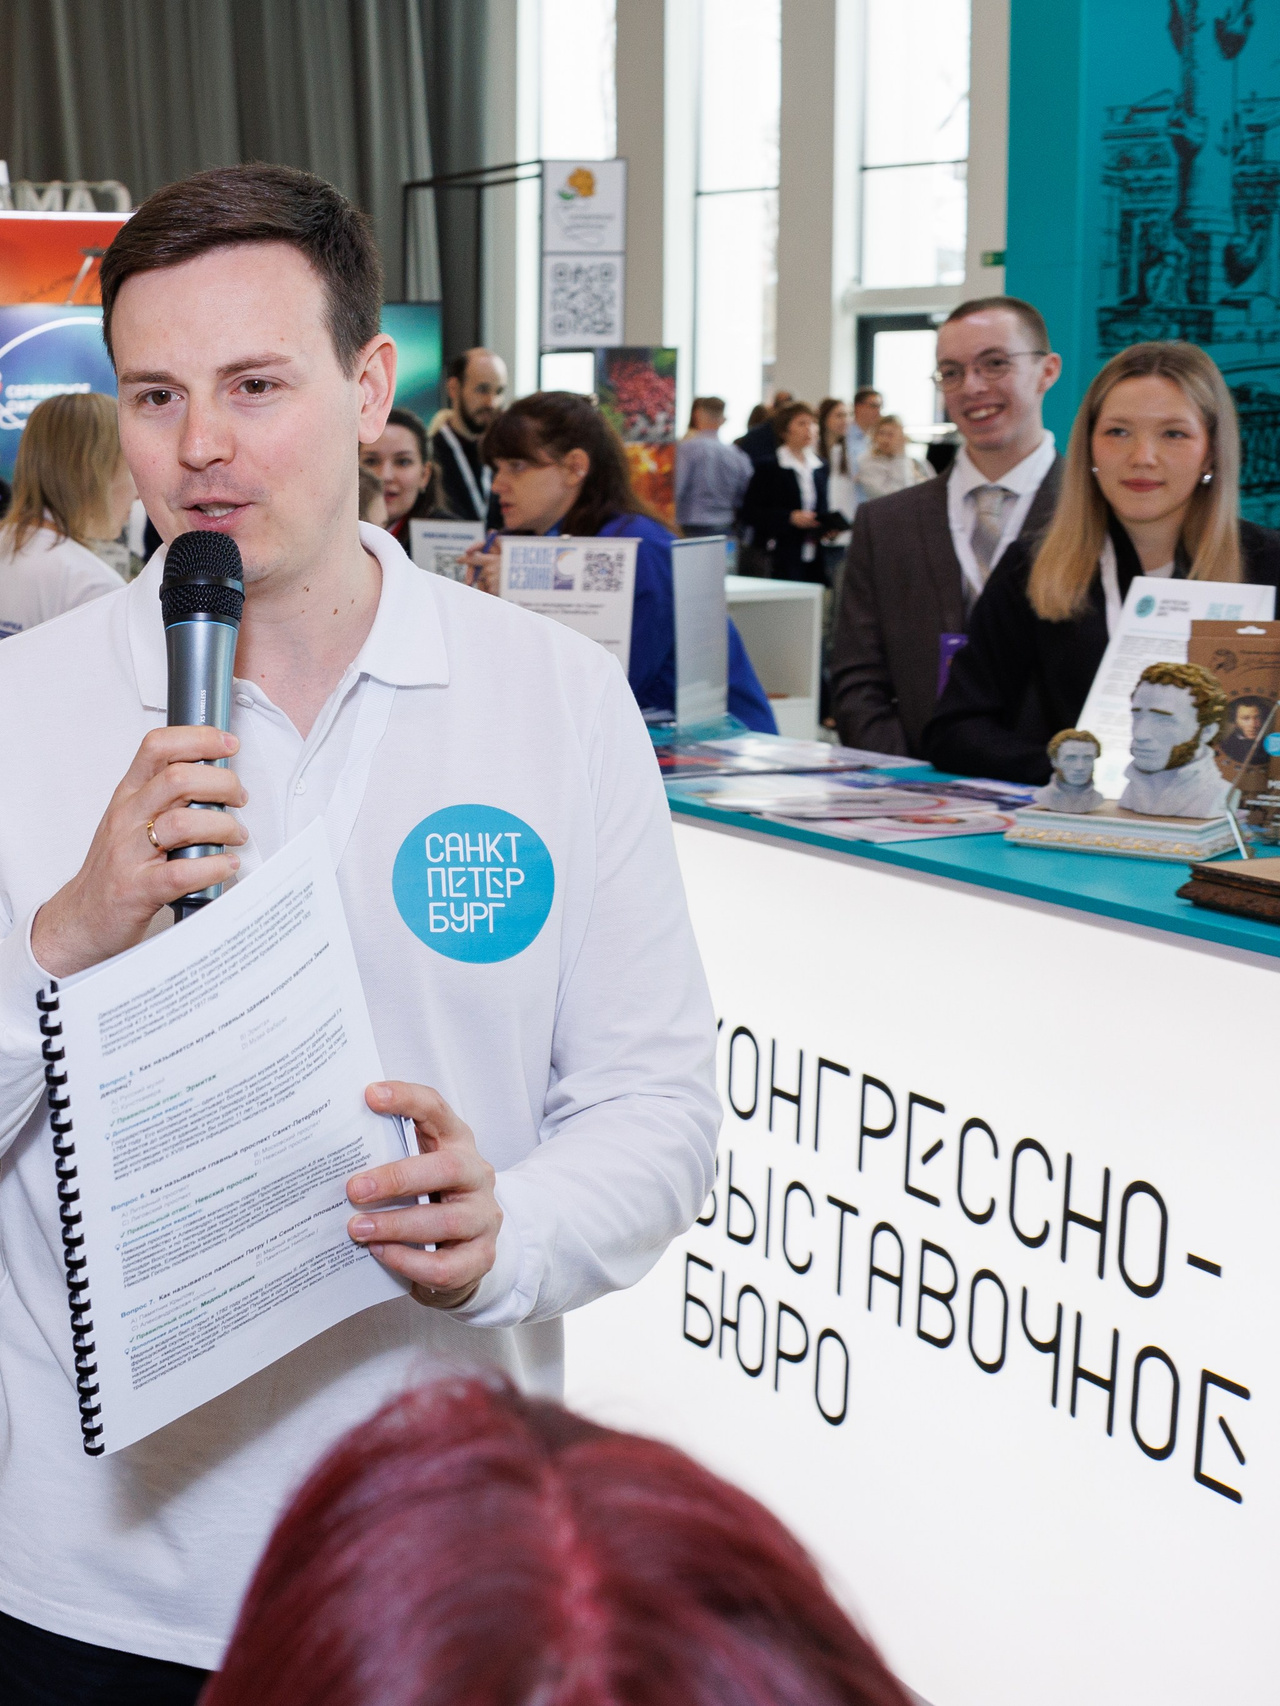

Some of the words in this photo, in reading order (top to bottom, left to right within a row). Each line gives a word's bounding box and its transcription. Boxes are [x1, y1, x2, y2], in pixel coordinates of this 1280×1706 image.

[425, 832, 522, 863] САНКТ
[427, 867, 525, 898] ПЕТЕР
[429, 902, 506, 934] БУРГ
[99, 1073, 126, 1089] Вопрос
[138, 1062, 151, 1072] Как
[153, 1041, 194, 1065] называется
[195, 1028, 217, 1044] музей,
[217, 1010, 245, 1031] главным
[246, 992, 269, 1013] зданием
[270, 975, 291, 996] которого
[292, 956, 313, 978] является
[313, 940, 329, 959] Зимний
[100, 1079, 132, 1100] дворец?
[116, 1099, 160, 1124] Правильный
[185, 1073, 216, 1092] Эрмитаж
[110, 1196, 138, 1212] Вопрос
[150, 1185, 162, 1194] Как
[163, 1165, 206, 1188] называется
[207, 1149, 238, 1168] главный
[239, 1134, 271, 1153] проспект
[271, 1098, 331, 1138] Санкт-Петербурга?
[717, 1017, 1222, 1299] ОНГРЕССНО-
[126, 1211, 169, 1235] Правильный
[194, 1186, 224, 1204] Невский
[226, 1171, 257, 1190] проспект
[120, 1302, 147, 1318] Вопрос
[158, 1291, 170, 1301] Как
[172, 1270, 212, 1294] называется
[213, 1253, 244, 1273] памятник
[245, 1241, 264, 1256] Петру
[269, 1234, 277, 1242] на
[278, 1214, 311, 1237] Сенатской
[312, 1196, 347, 1218] площади?
[135, 1315, 177, 1340] Правильный
[200, 1288, 227, 1308] Медный
[228, 1274, 255, 1292] всадник
[683, 1251, 850, 1426] БЮРО
